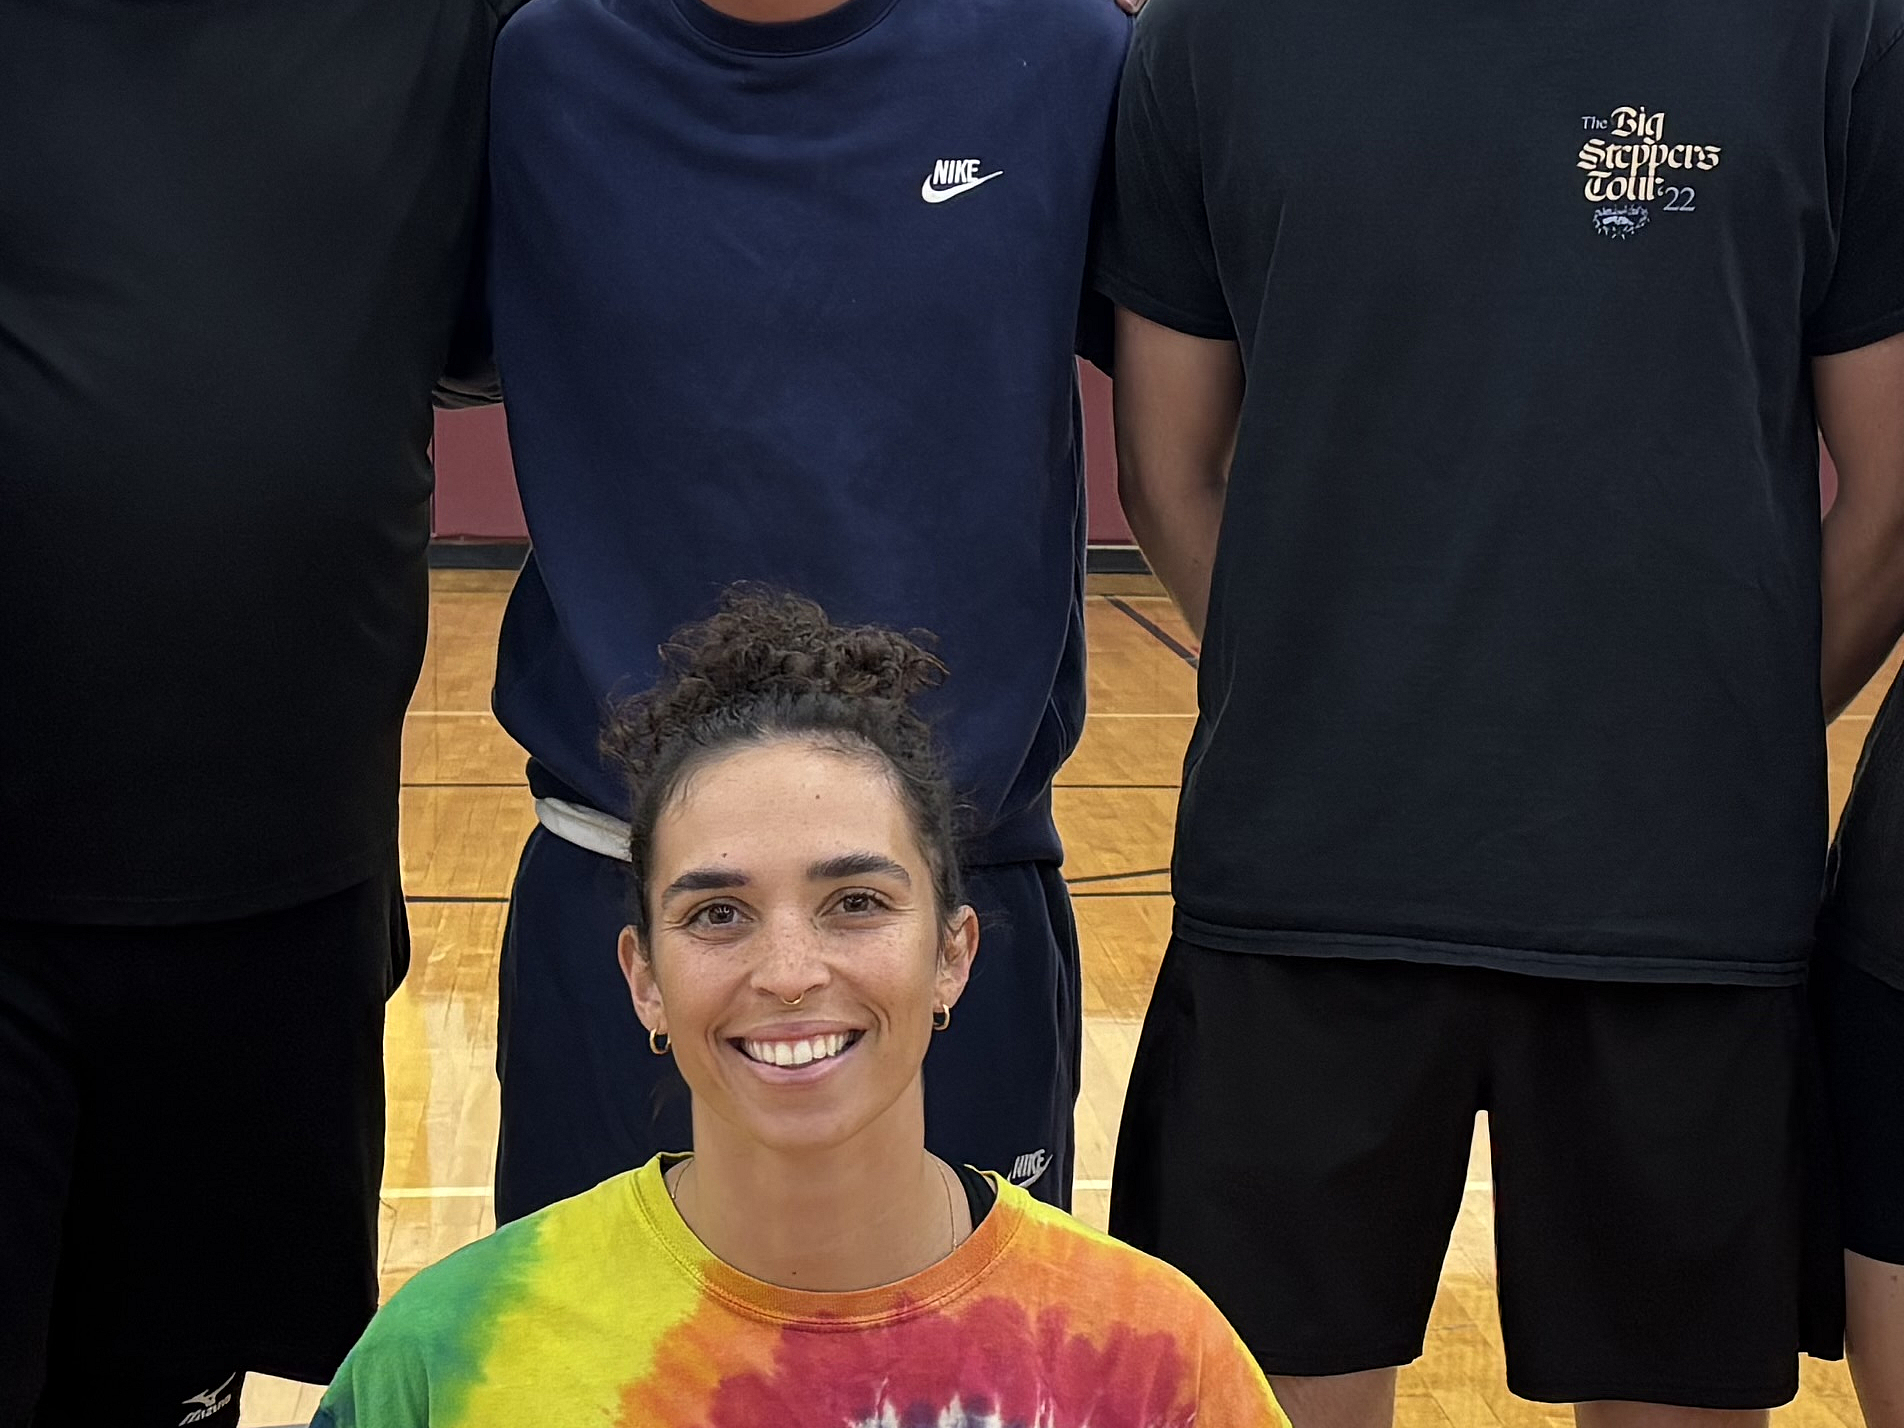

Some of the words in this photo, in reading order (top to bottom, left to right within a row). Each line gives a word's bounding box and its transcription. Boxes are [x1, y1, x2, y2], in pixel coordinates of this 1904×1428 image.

[1581, 115, 1608, 130] The
[1610, 106, 1665, 145] Big
[932, 159, 981, 185] NIKE
[1576, 138, 1722, 178] Steppers
[1011, 1148, 1046, 1180] NIKE
